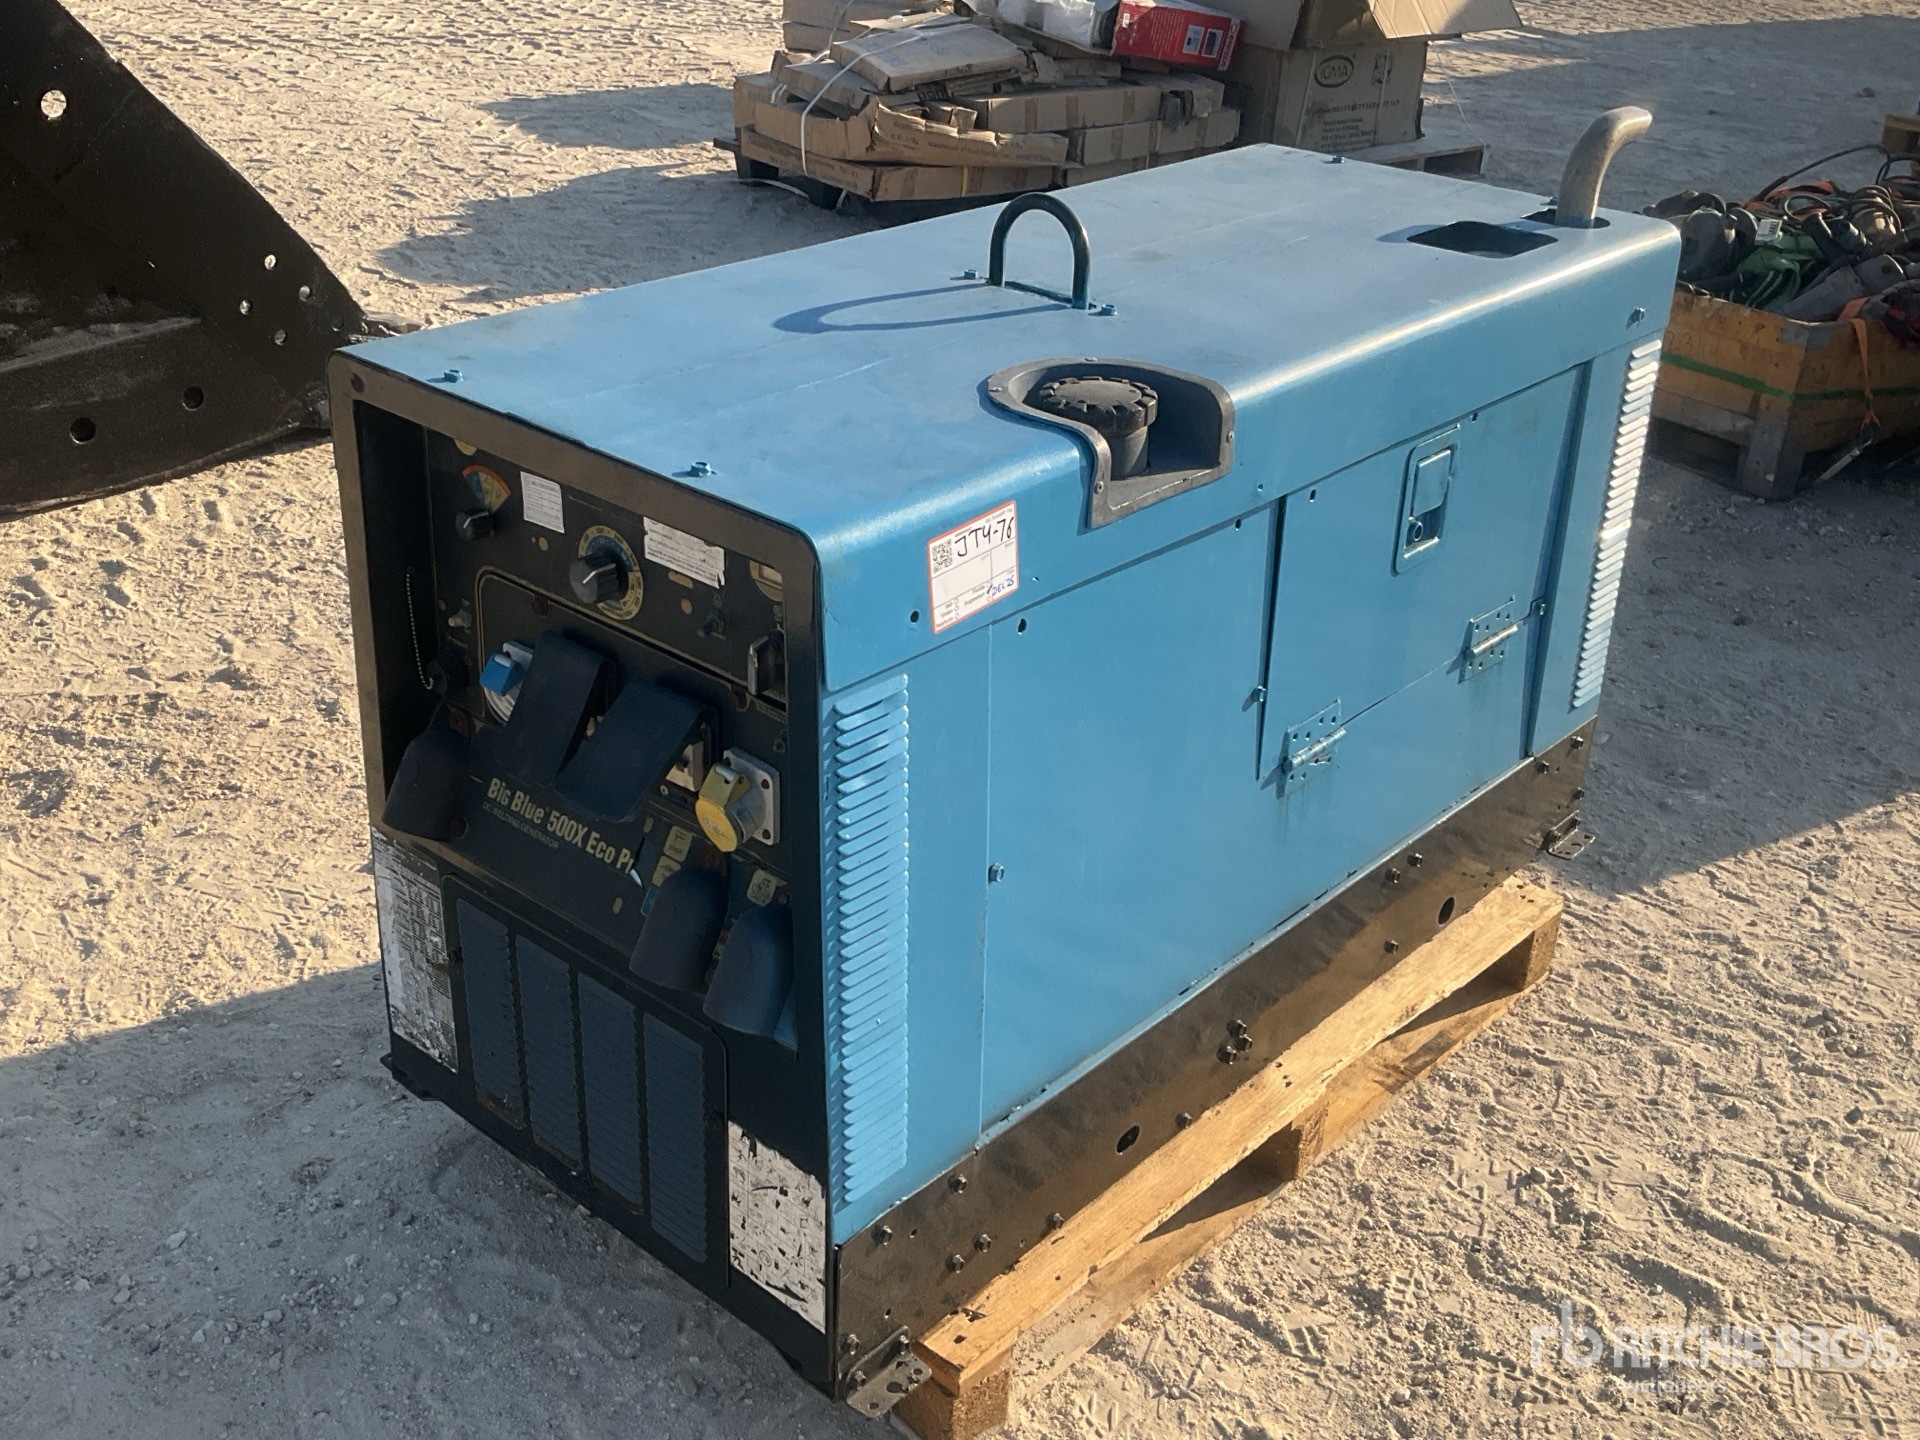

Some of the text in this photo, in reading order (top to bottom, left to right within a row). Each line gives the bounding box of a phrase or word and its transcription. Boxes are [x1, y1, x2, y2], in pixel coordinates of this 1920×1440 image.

[491, 806, 521, 830] WELDING
[520, 820, 560, 850] GENERATOR
[511, 790, 544, 823] Blue
[548, 810, 589, 846] 500X
[585, 833, 616, 864] Eco
